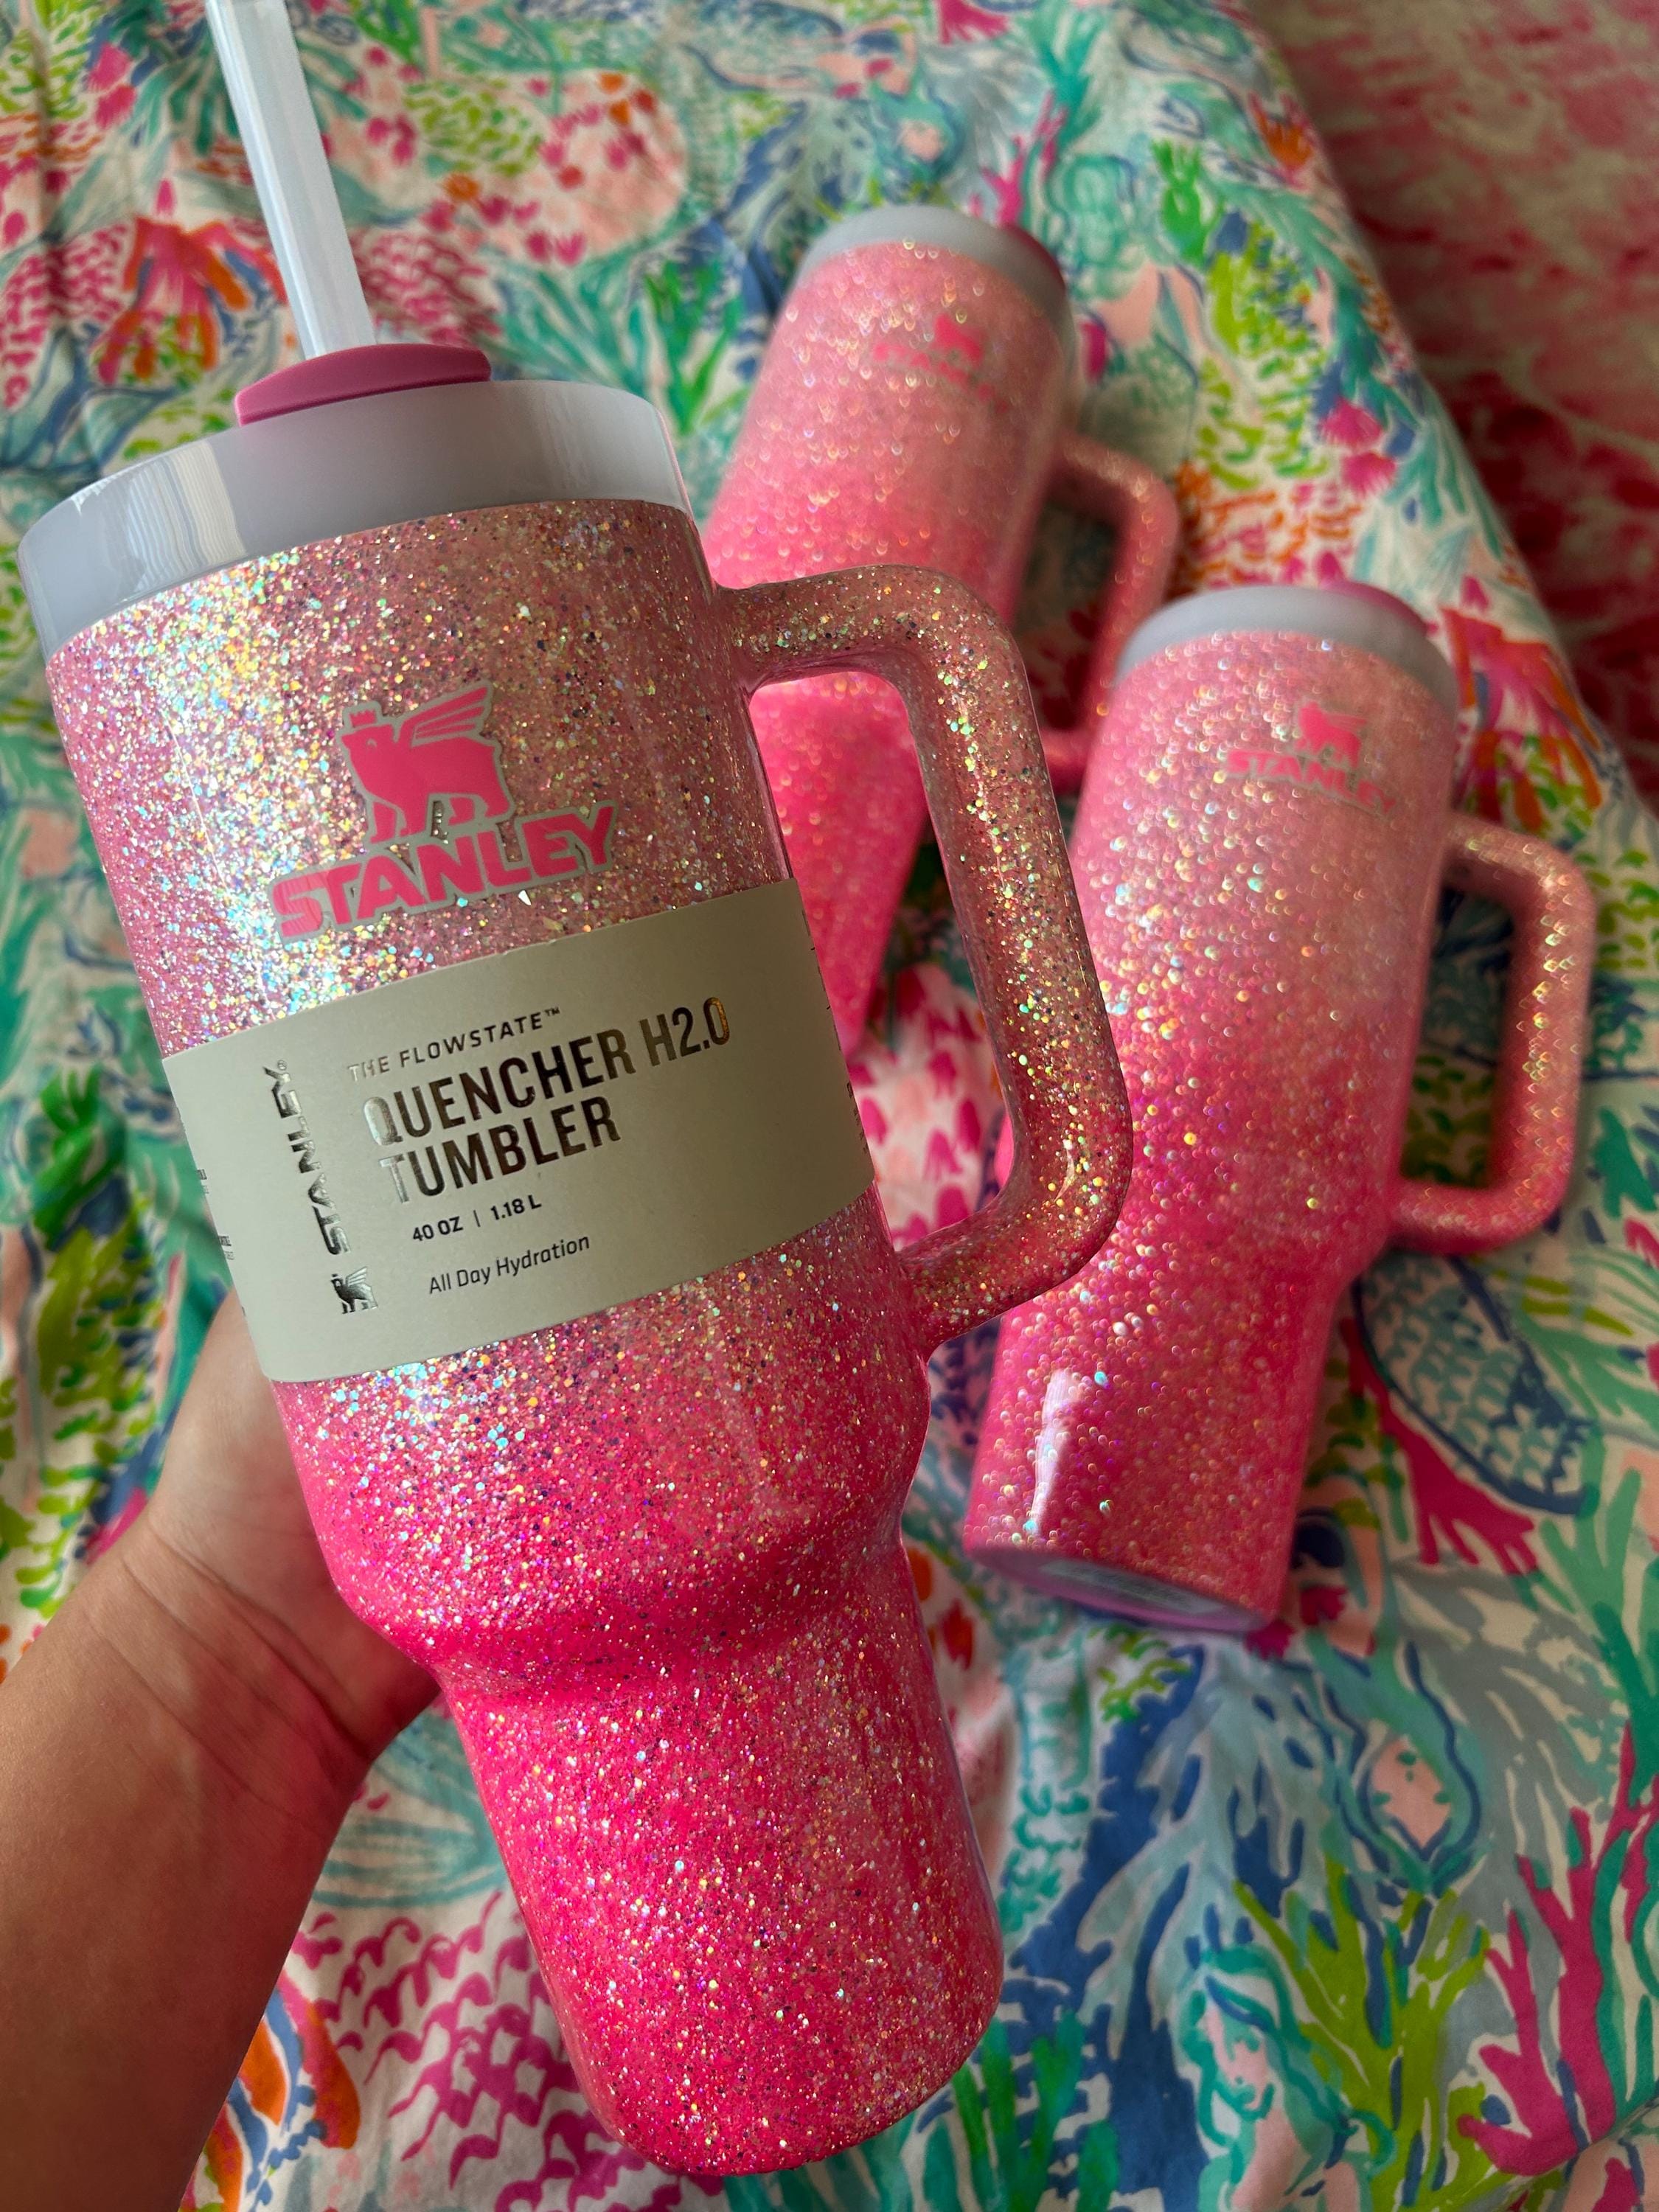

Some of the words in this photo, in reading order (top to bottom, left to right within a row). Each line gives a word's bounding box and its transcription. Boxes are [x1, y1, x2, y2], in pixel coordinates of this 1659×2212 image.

[271, 805, 616, 938] STANLEY
[347, 1056, 391, 1082] THE
[362, 1028, 636, 1147] QUENCHER
[639, 996, 731, 1067] H2.0
[379, 1096, 621, 1203] TUMBLER
[411, 1225, 434, 1242] 40
[438, 1216, 464, 1236] OZ
[490, 1198, 525, 1221] 1.18
[529, 1194, 543, 1211] L
[429, 1273, 453, 1295] All
[456, 1265, 491, 1287] Day
[495, 1235, 590, 1277] Hydration
